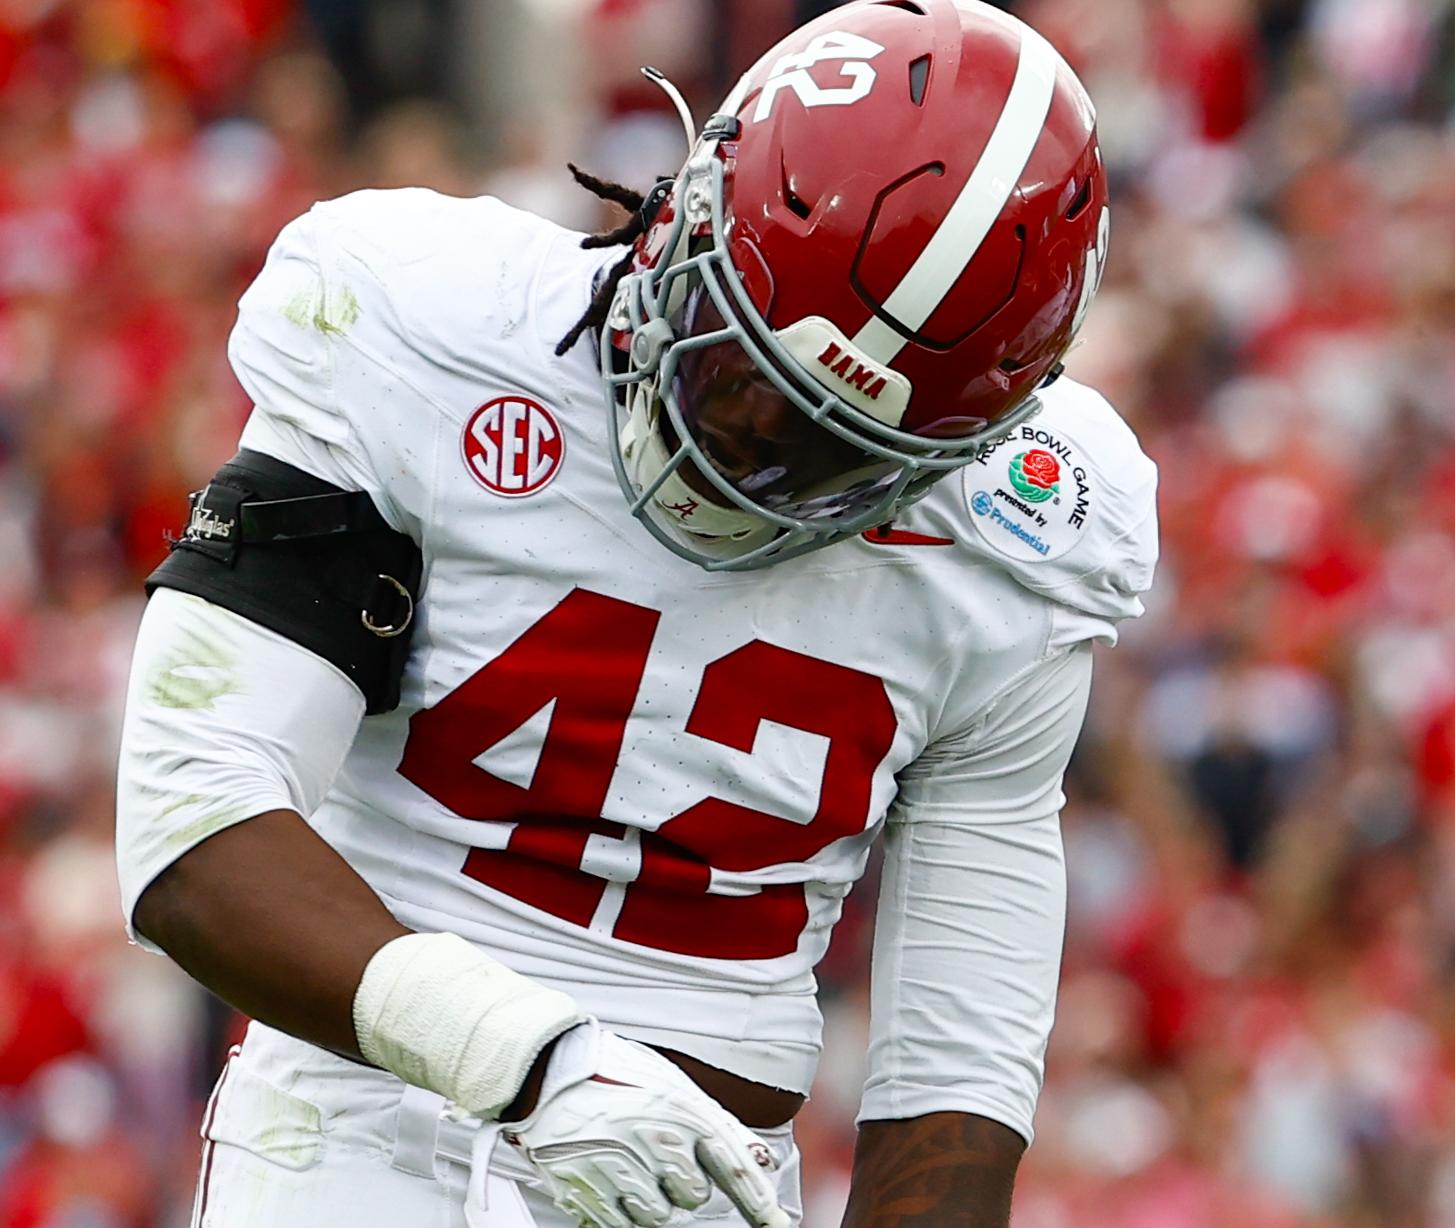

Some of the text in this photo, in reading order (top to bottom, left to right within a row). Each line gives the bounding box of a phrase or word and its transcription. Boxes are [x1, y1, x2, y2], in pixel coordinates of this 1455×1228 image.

[753, 31, 886, 124] 42
[817, 341, 888, 400] BAMA
[471, 400, 556, 488] SEC
[1022, 426, 1072, 466] BOWL
[1068, 467, 1090, 530] GAME
[990, 507, 1051, 556] Prudential
[993, 488, 1048, 527] presented by
[396, 587, 898, 960] 42
